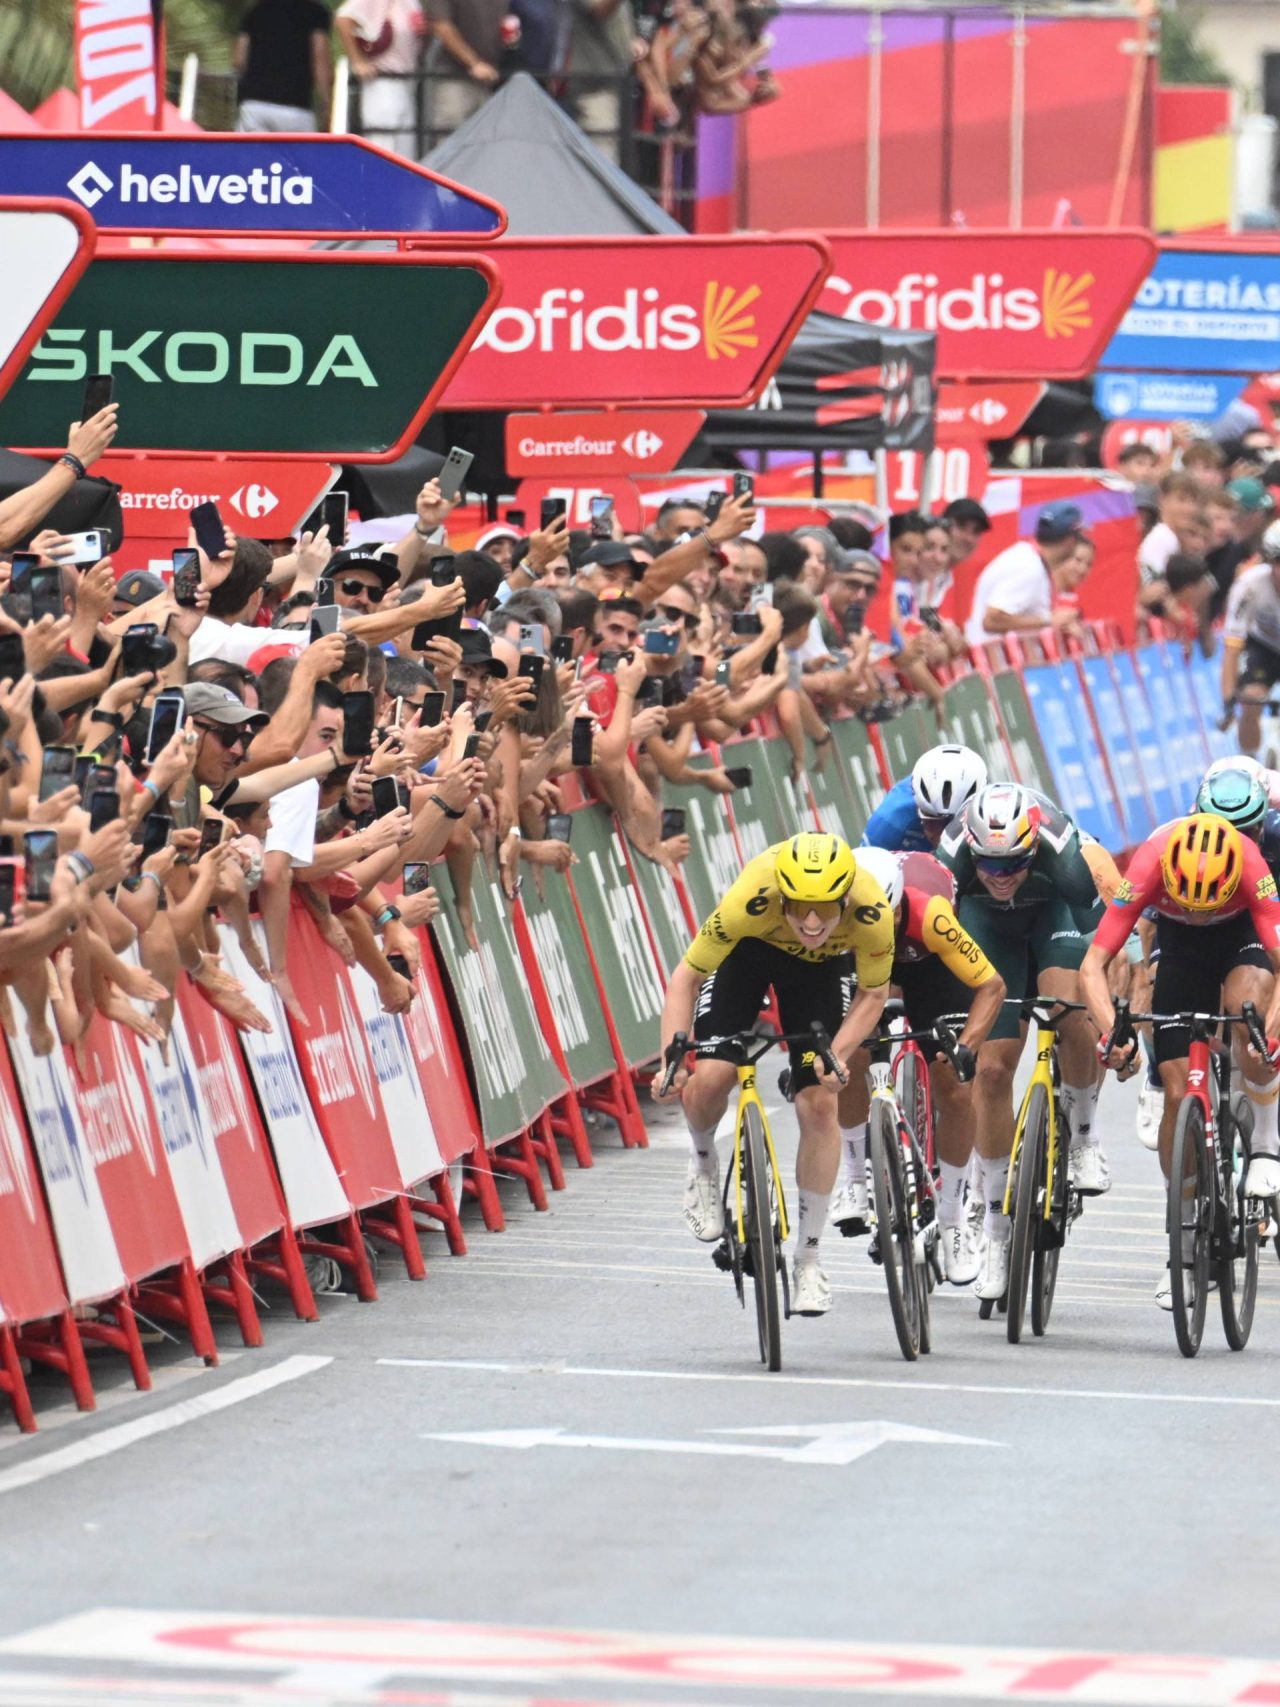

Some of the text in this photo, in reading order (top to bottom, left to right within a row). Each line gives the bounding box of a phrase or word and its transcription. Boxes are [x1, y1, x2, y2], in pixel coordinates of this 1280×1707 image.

[120, 162, 313, 204] helvetia
[470, 287, 701, 352] ofidis
[519, 436, 616, 457] Carrefour
[118, 487, 221, 510] arrefour
